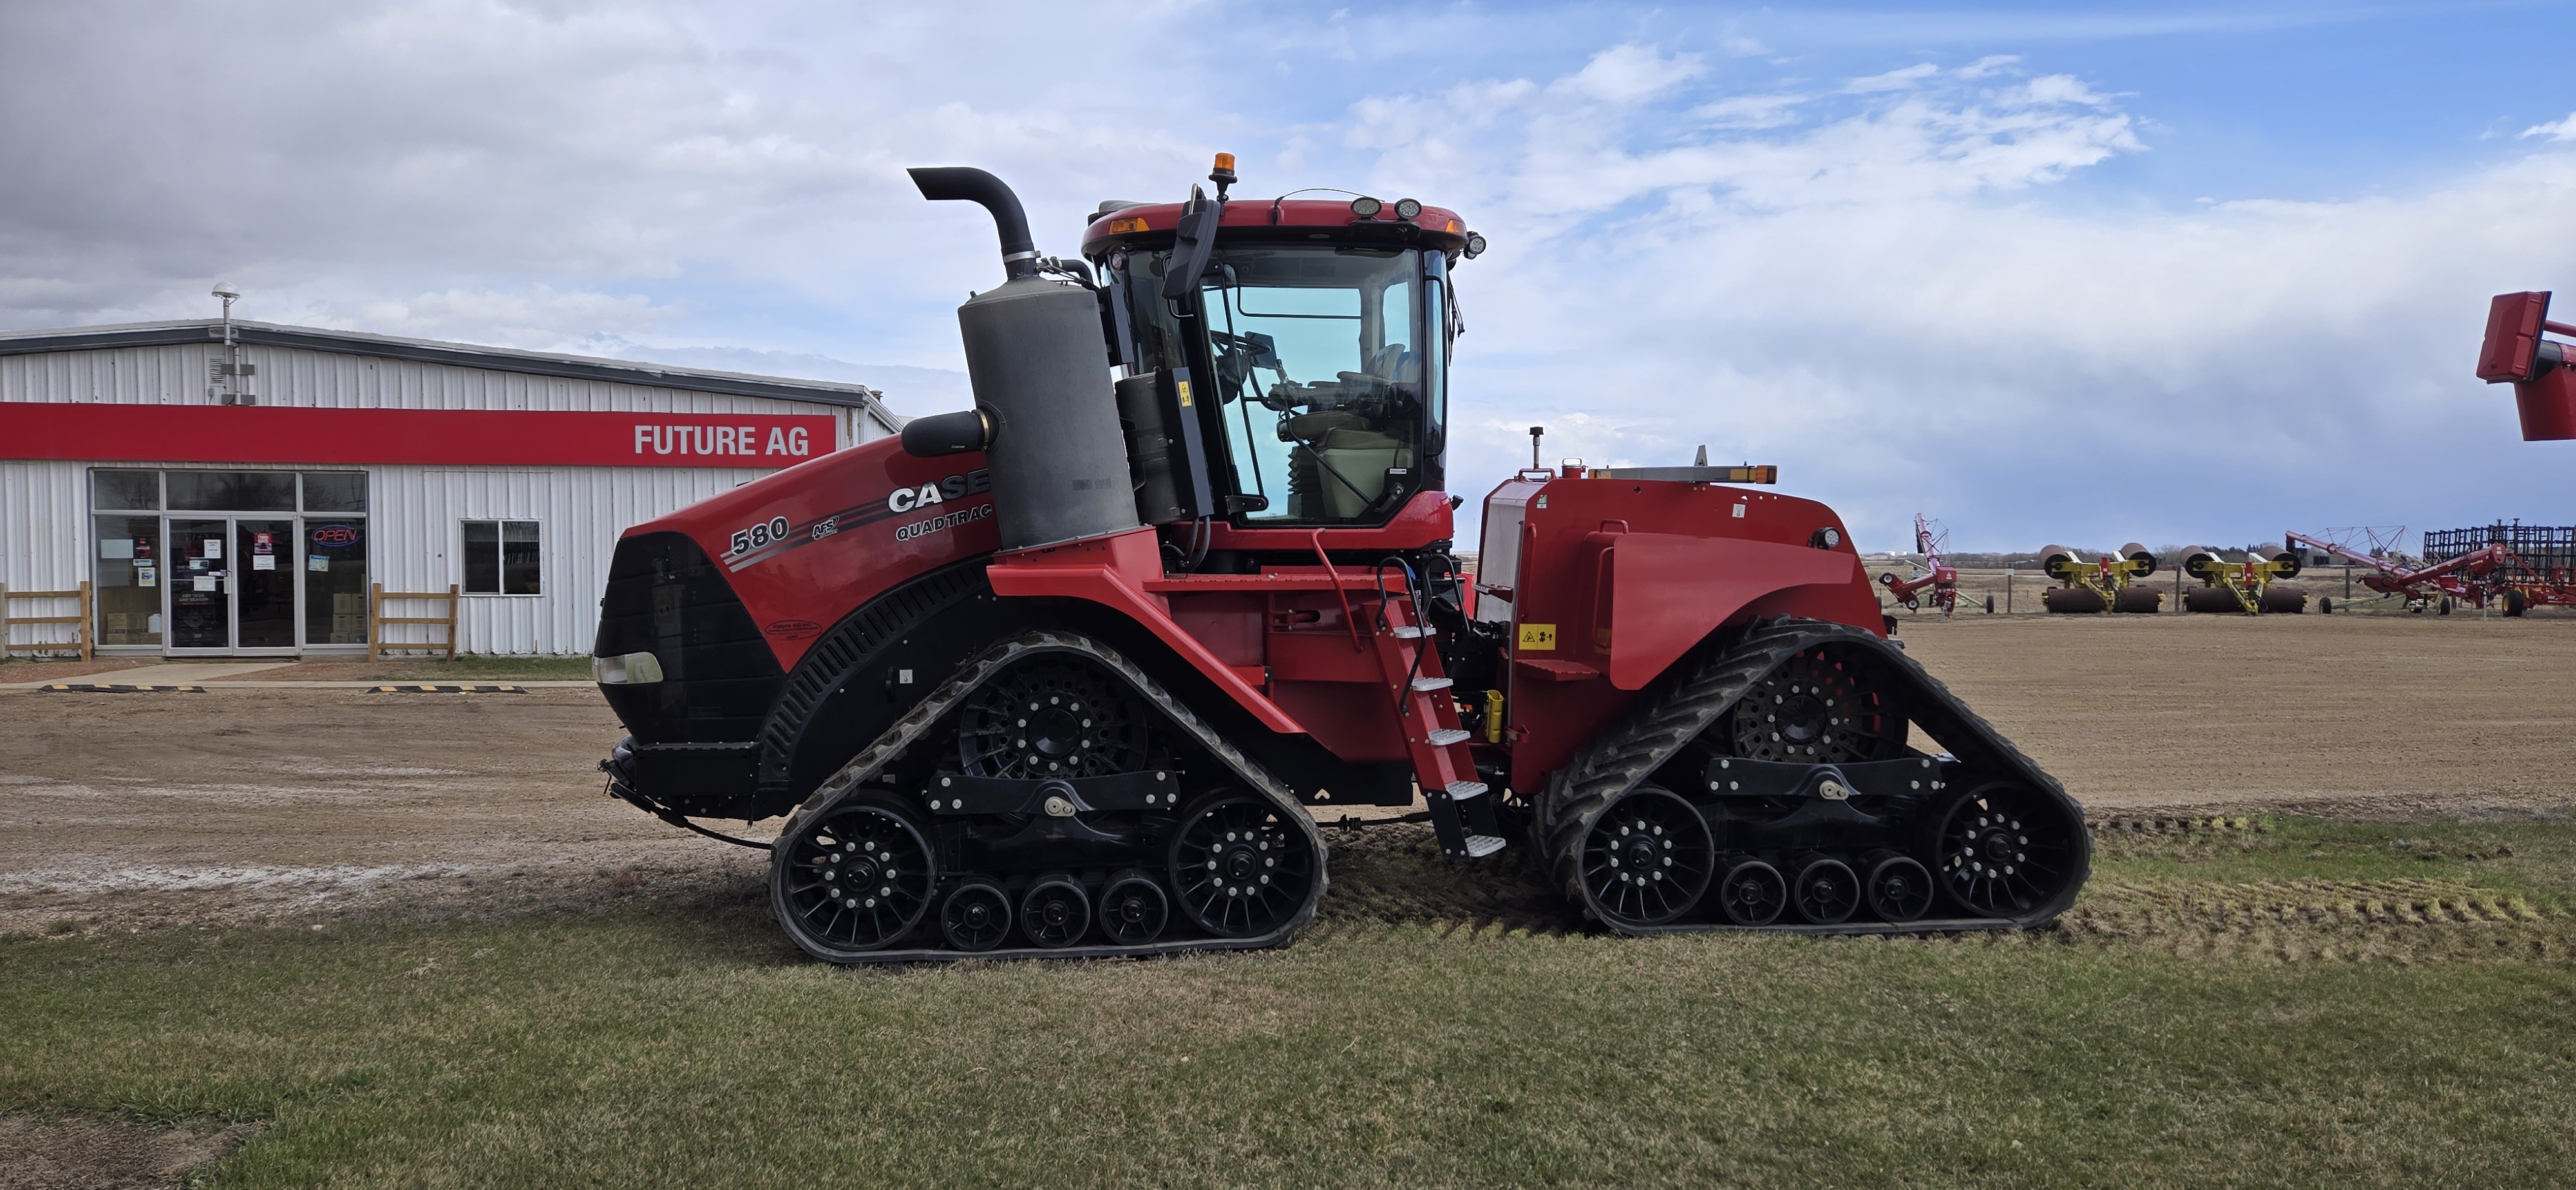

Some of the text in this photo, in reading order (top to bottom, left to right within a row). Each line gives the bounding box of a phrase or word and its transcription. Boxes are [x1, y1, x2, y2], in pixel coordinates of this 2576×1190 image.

[634, 425, 809, 456] FUTURE AG
[888, 468, 990, 513] CASE
[313, 529, 357, 542] OPEN
[731, 516, 790, 556] 580
[811, 519, 835, 538] AFS
[896, 504, 992, 542] QUADTRAC
